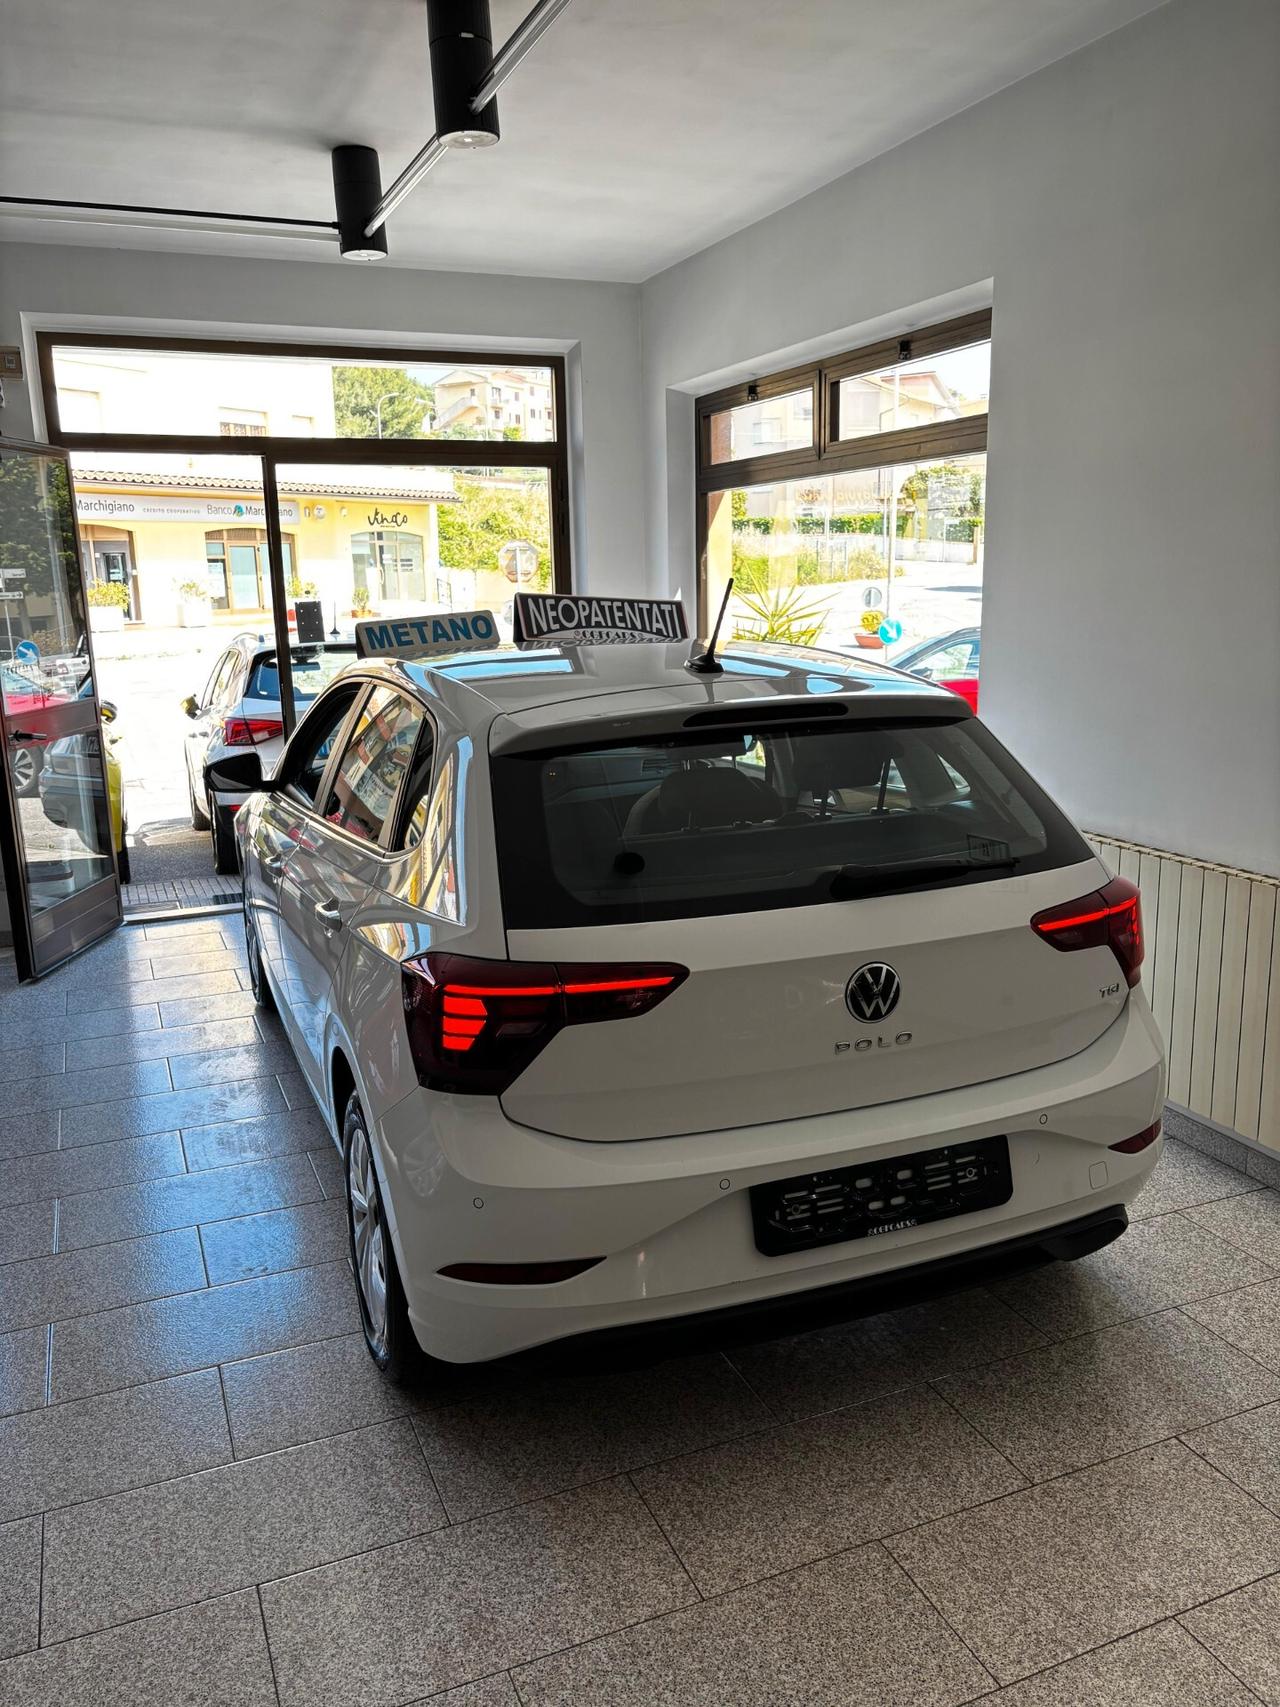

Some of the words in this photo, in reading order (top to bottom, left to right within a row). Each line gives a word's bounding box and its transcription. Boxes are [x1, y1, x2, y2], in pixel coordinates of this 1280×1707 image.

[77, 500, 135, 514] Marchigiano
[207, 505, 232, 515] Banco
[527, 598, 680, 638] NEOPATENTATI
[364, 614, 493, 650] METANO
[834, 1031, 912, 1055] POLO
